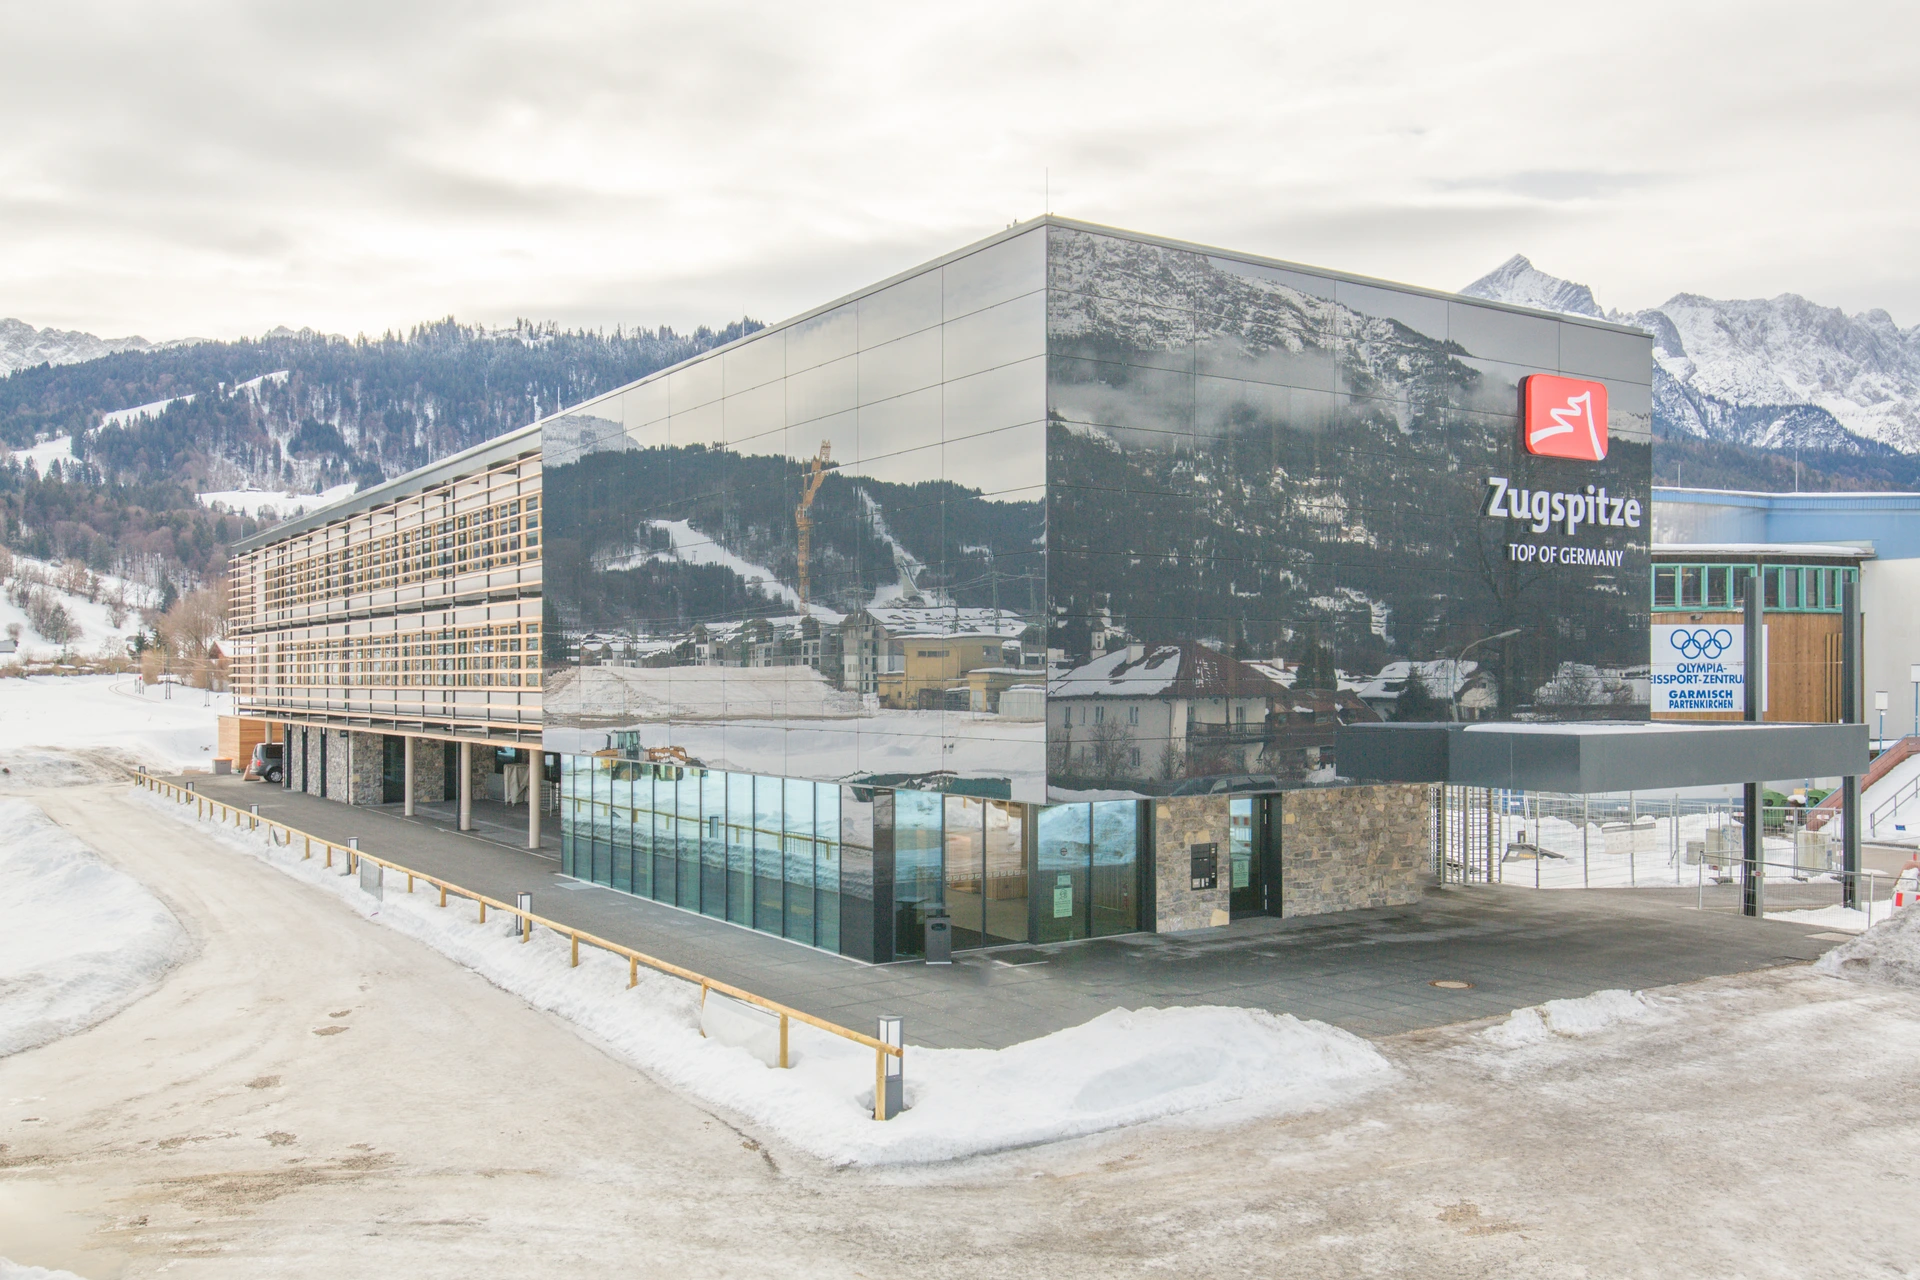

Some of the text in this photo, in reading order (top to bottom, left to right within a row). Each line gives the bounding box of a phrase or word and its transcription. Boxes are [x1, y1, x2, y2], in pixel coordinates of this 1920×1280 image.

[1489, 477, 1641, 535] Zugspitze
[1509, 543, 1624, 567] TOP OF GERMANY
[1677, 663, 1727, 673] OLYMPIA-
[1669, 690, 1733, 698] GARMISCH
[1669, 700, 1733, 709] PARTENKIRCHEN
